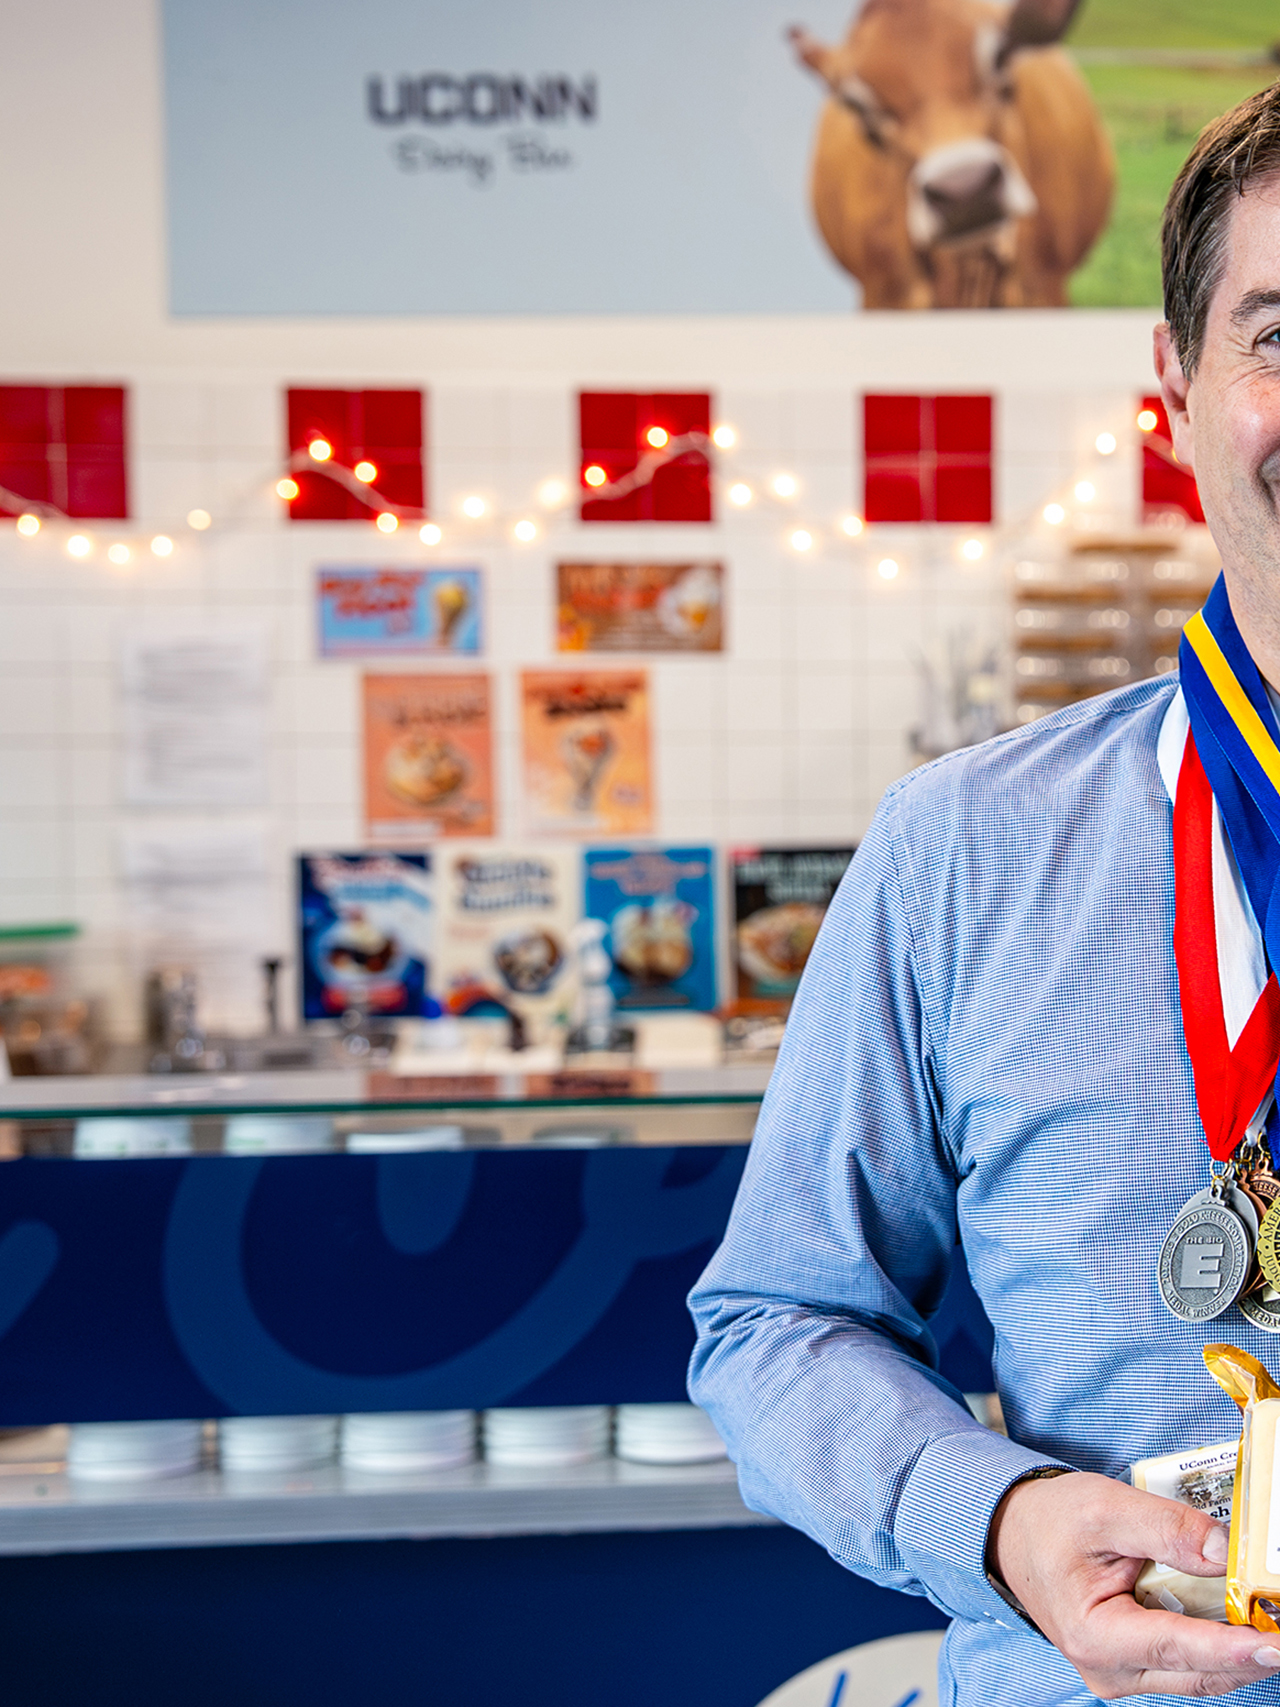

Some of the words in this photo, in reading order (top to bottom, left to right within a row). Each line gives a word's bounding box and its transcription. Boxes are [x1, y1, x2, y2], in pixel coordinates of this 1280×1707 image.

[365, 70, 599, 127] UCONN
[1178, 1213, 1199, 1234] GOLD
[1201, 1210, 1230, 1227] CHEESE
[1186, 1236, 1203, 1244] THE
[1180, 1243, 1224, 1289] E
[1167, 1290, 1191, 1316] MEDAL
[1179, 1457, 1217, 1471] UConn
[1208, 1496, 1231, 1507] Farm
